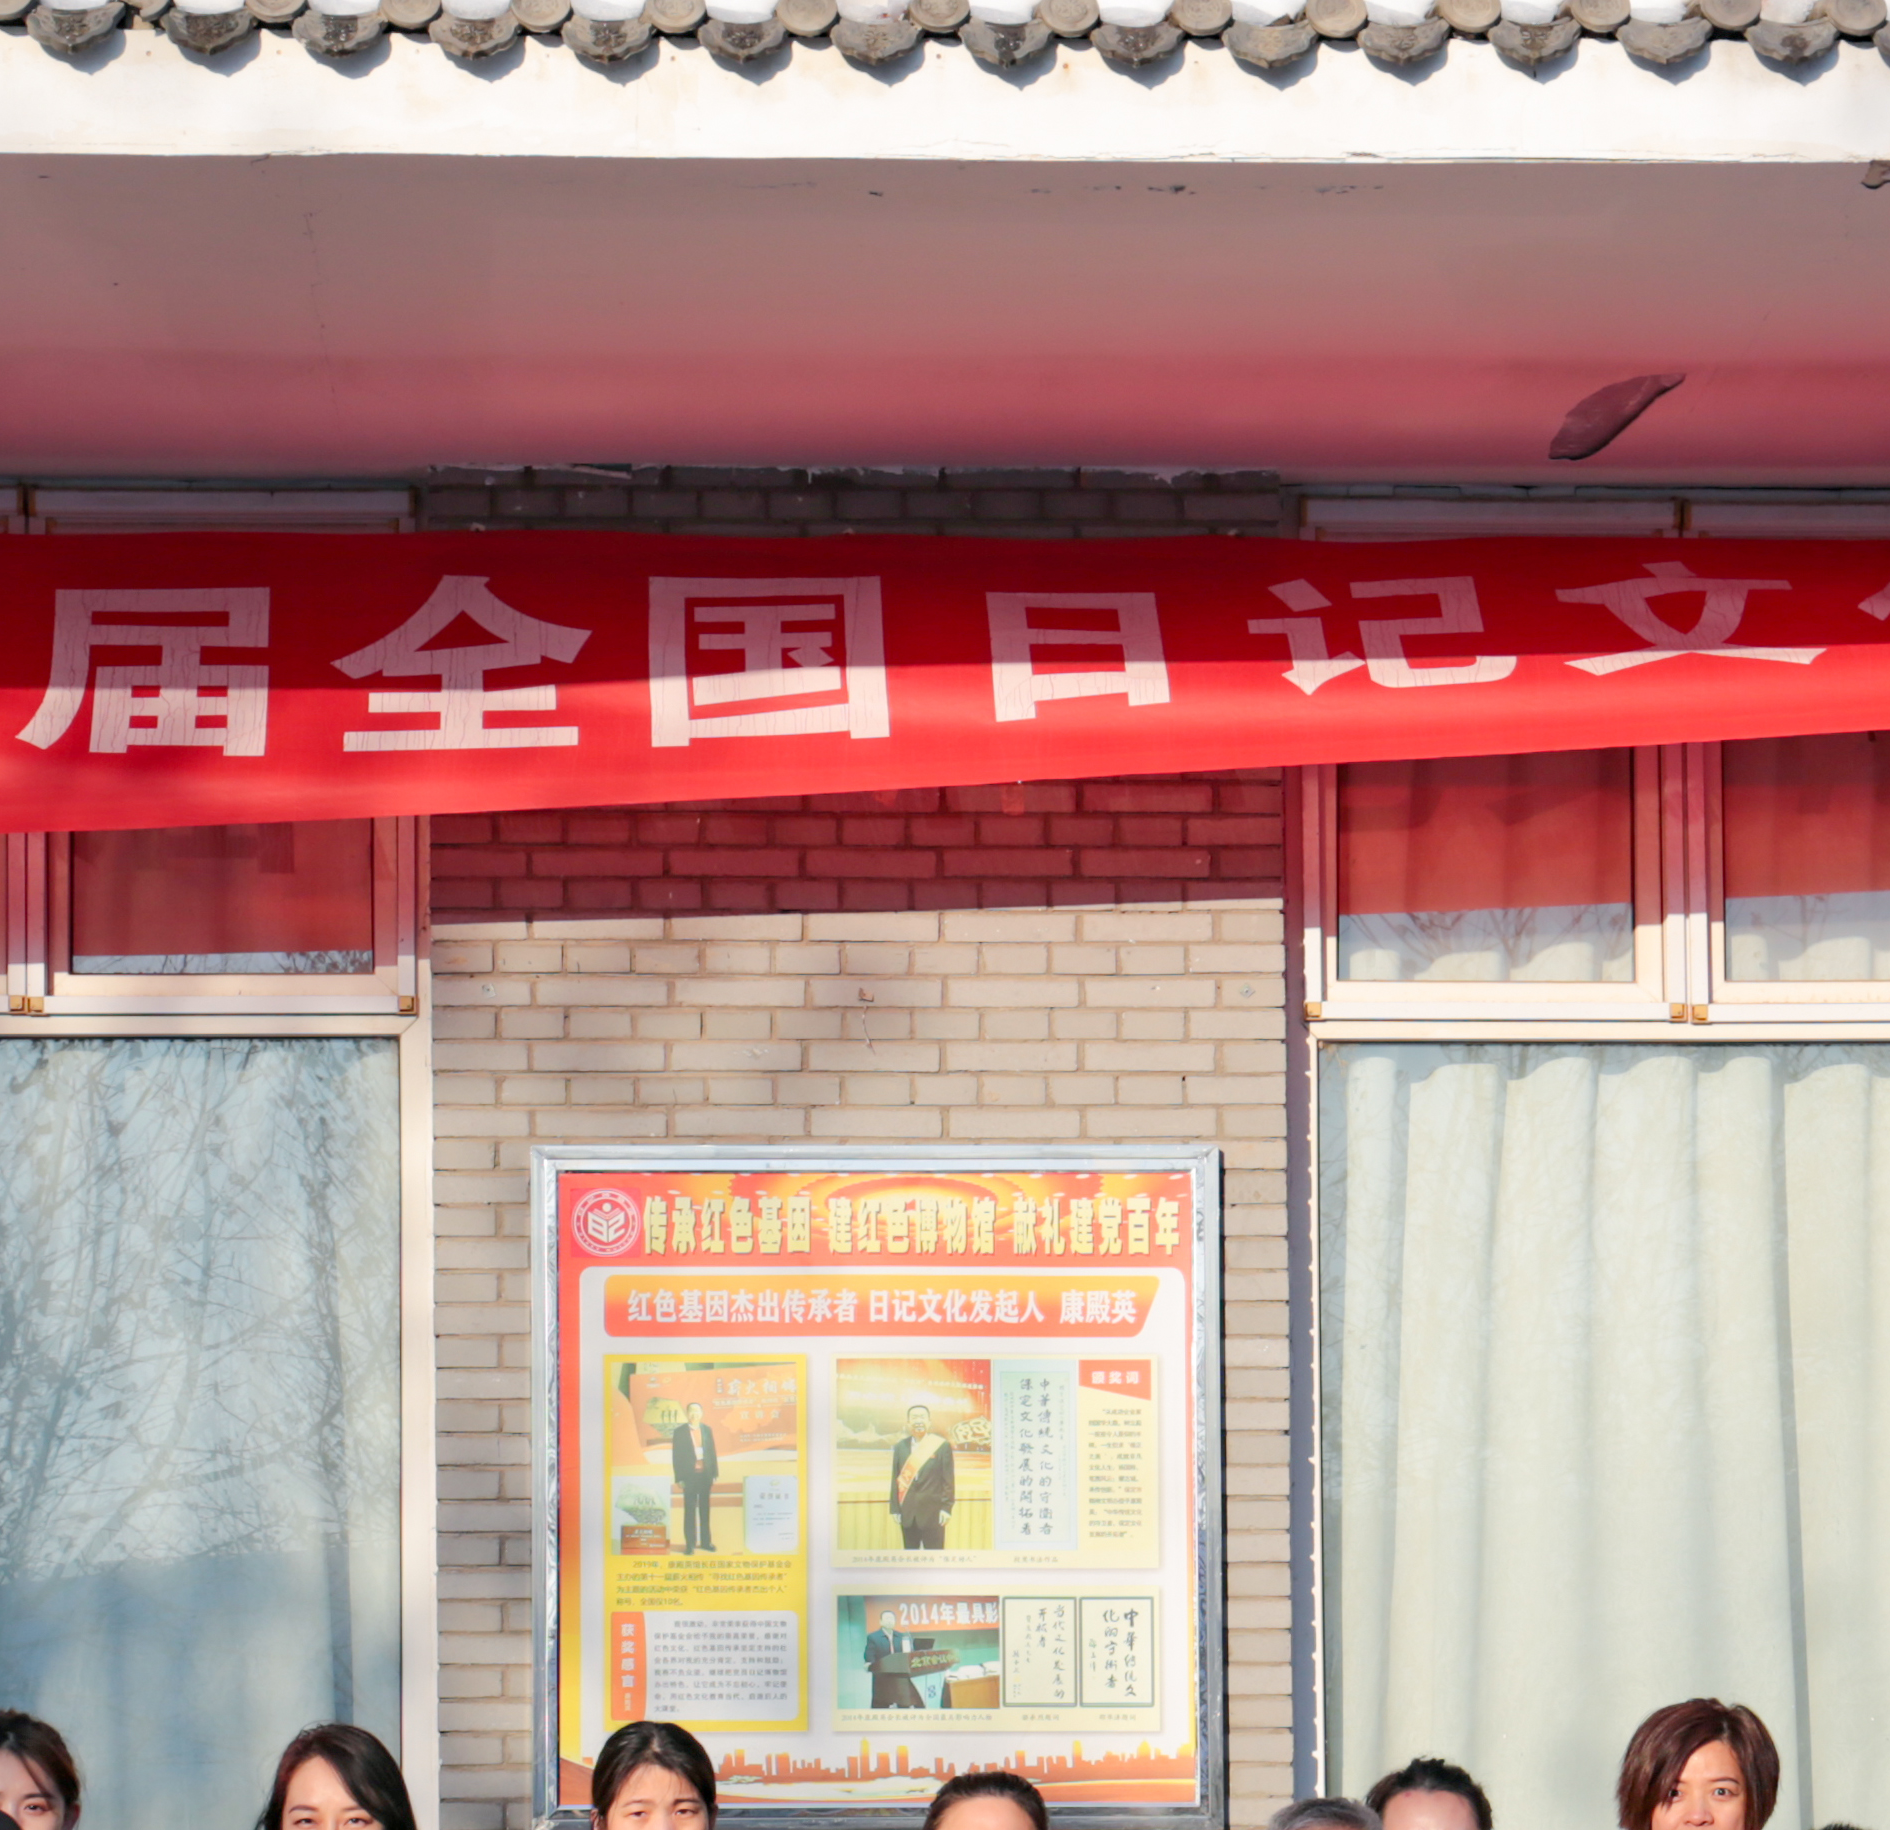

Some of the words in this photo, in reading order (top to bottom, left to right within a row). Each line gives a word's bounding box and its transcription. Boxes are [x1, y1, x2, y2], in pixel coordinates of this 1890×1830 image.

[643, 1195, 811, 1256] 传承红色基因
[828, 1194, 997, 1256] 建红色博物馆
[1012, 1195, 1181, 1257] 献礼建党百年
[627, 1288, 856, 1325] 红色基因杰出传承者
[868, 1287, 1045, 1324] 日记文化发起人
[1059, 1287, 1137, 1323] 康殿英
